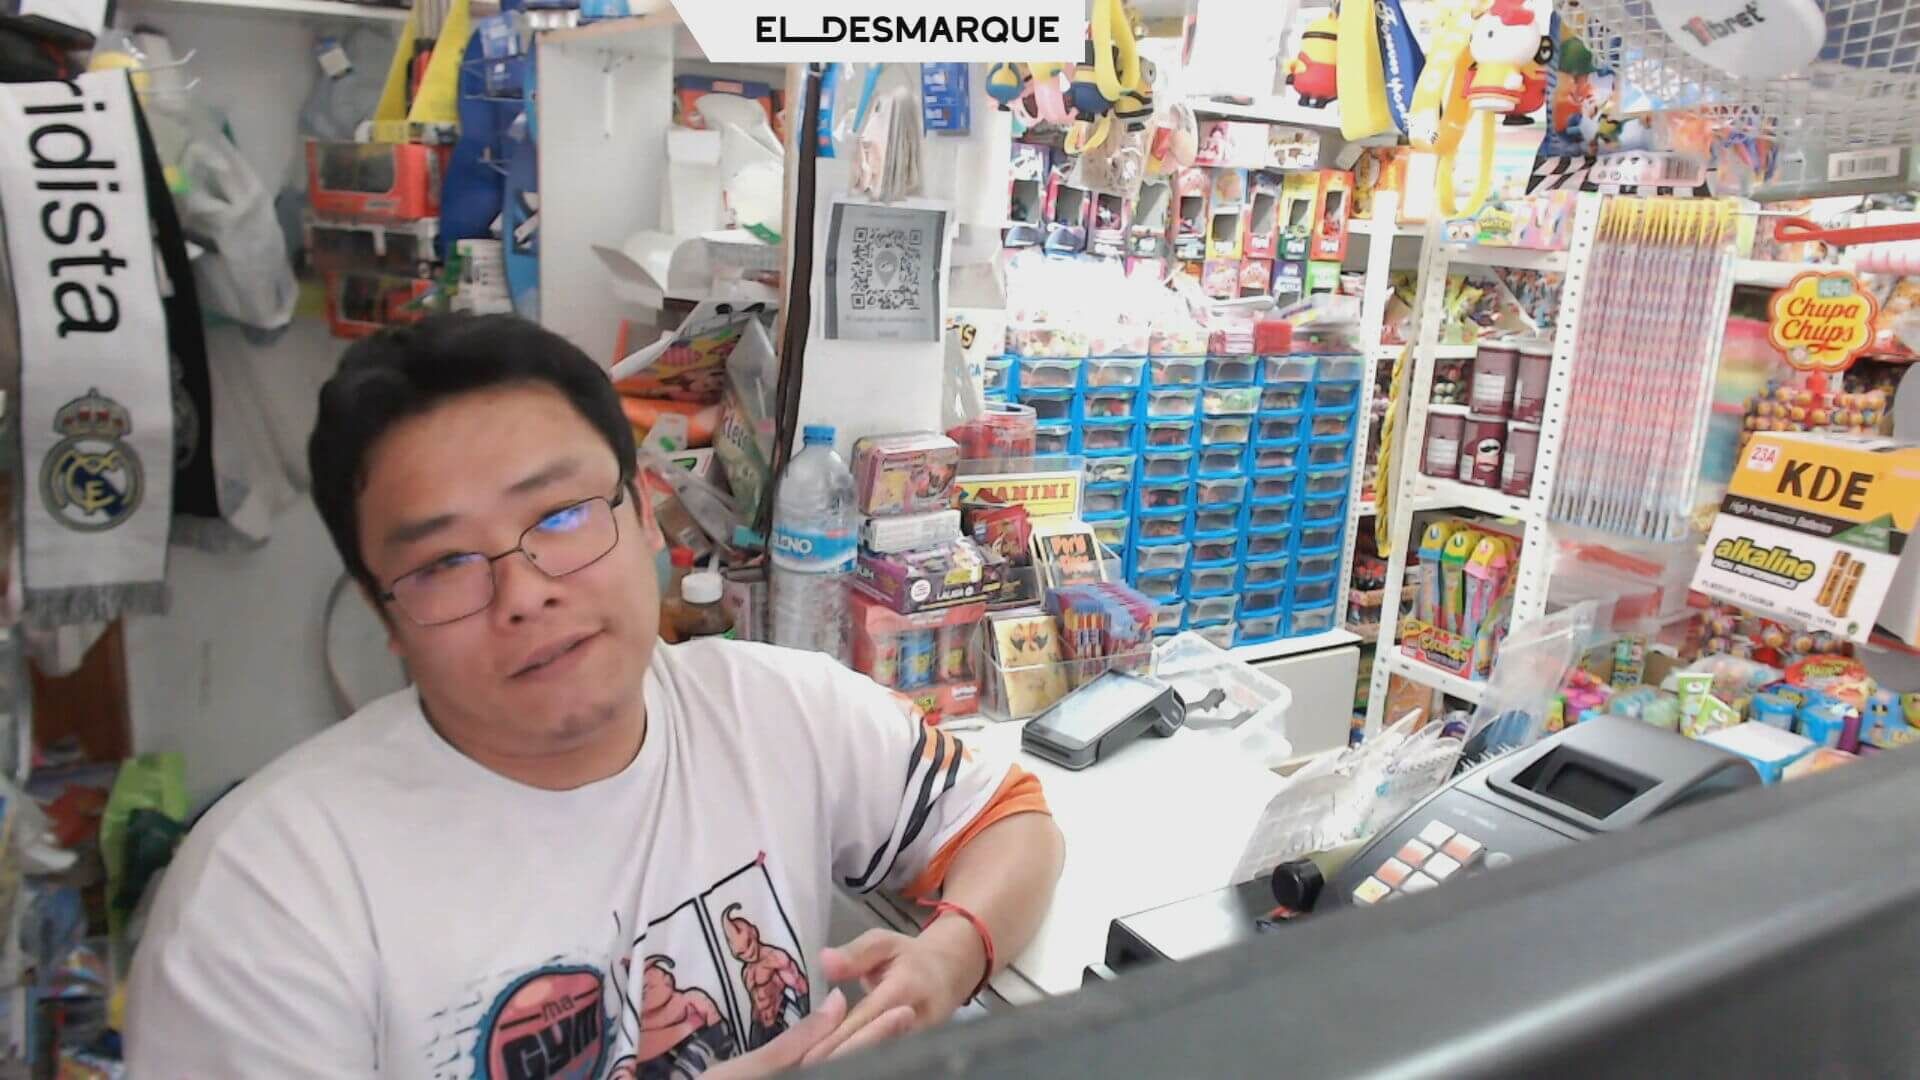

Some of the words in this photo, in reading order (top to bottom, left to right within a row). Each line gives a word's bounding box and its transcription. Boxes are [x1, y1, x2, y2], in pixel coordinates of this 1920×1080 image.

[1787, 297, 1859, 323] Chupa
[1781, 318, 1854, 354] Chups
[996, 483, 1071, 502] ANINI
[1776, 459, 1873, 510] KDE
[1714, 537, 1816, 582] alkaline
